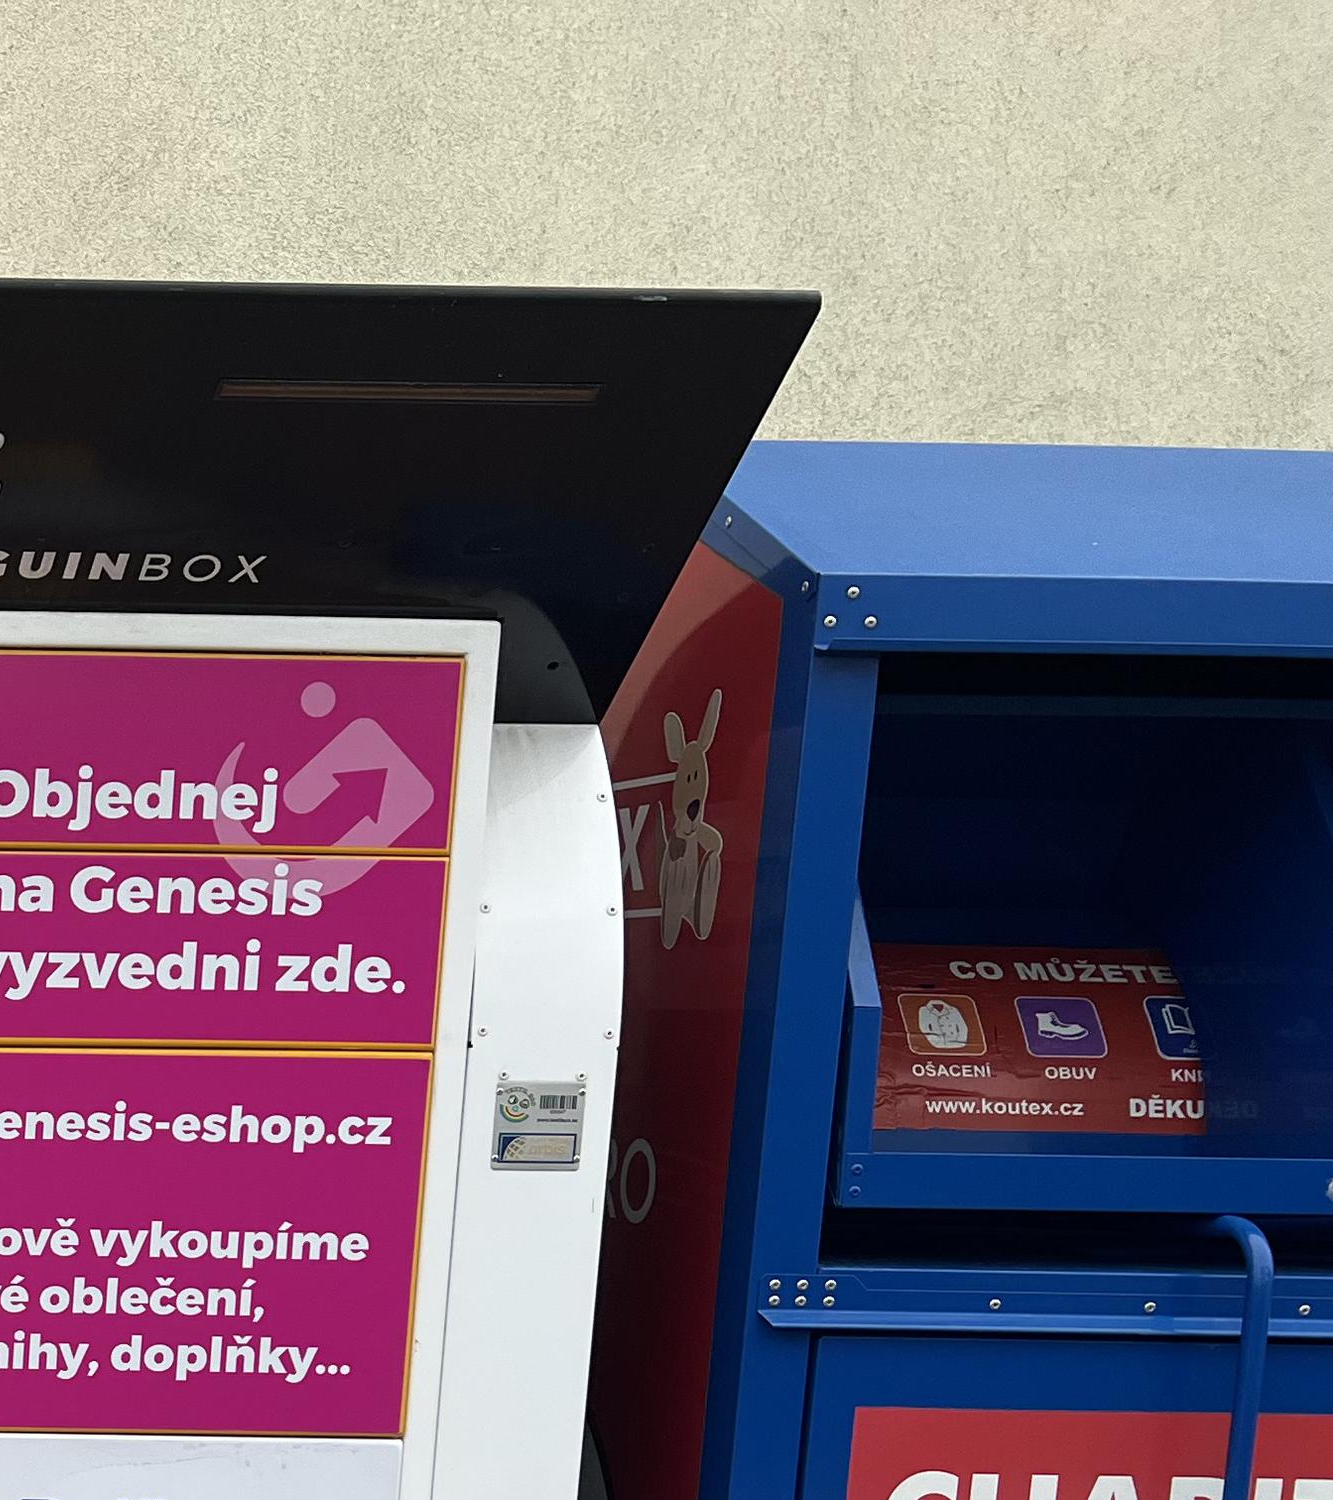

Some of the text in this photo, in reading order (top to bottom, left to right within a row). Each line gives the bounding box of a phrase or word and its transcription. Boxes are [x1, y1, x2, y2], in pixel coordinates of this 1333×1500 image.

[69, 864, 323, 916] Genesis
[274, 944, 407, 994] zde.
[949, 958, 1178, 984] CO MŮŽETE
[912, 1061, 991, 1078] OŠACENÍ
[1045, 1066, 1097, 1080] OBUV
[926, 1099, 1084, 1116] www.koutex.cz
[90, 1221, 369, 1268] vykoupíme
[39, 1276, 265, 1322] oblečení,
